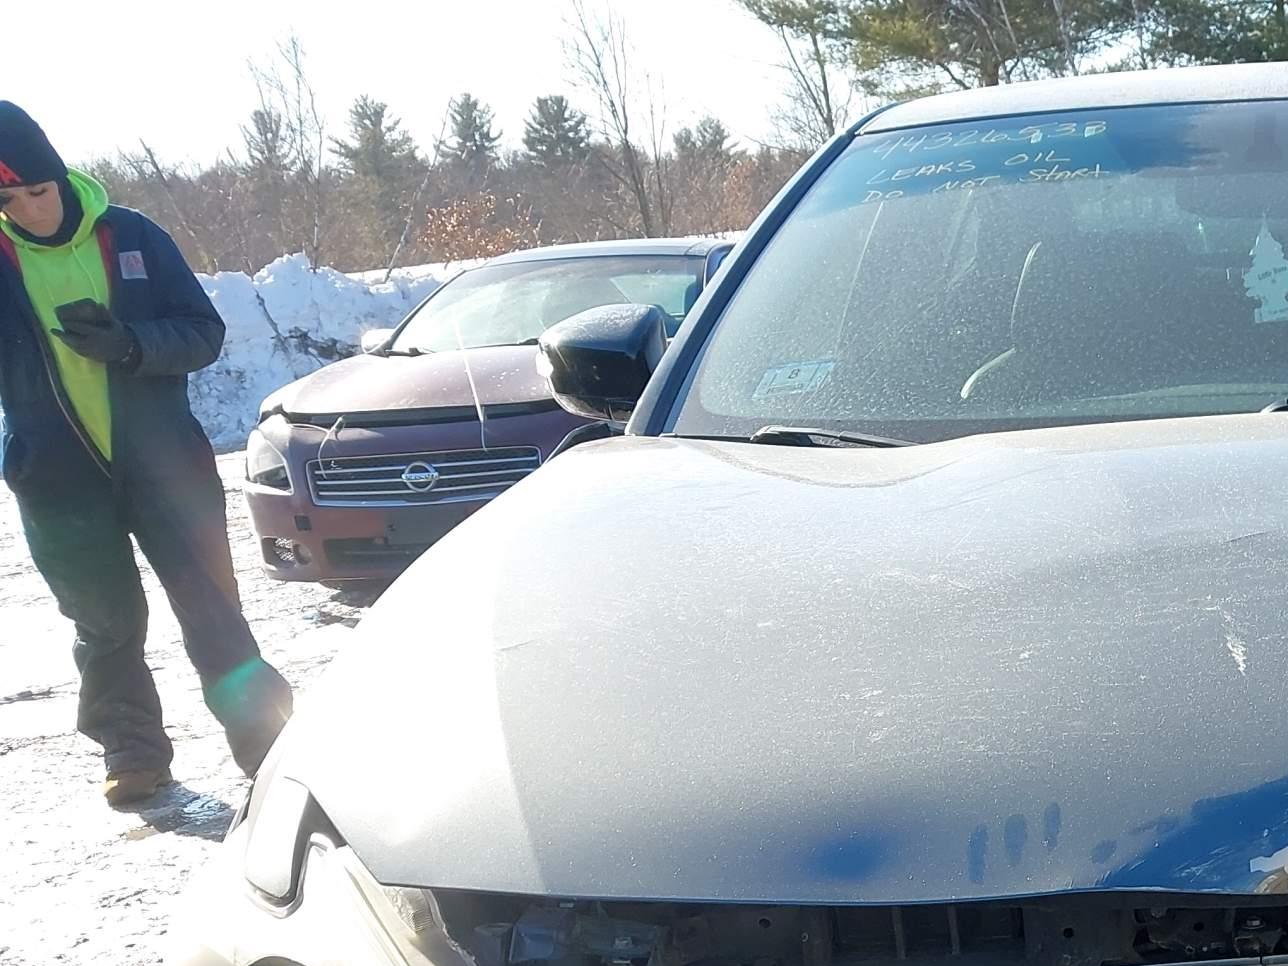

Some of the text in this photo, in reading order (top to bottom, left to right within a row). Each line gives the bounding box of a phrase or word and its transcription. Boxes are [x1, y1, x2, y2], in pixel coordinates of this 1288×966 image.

[866, 151, 1071, 185] LEAKS OIL
[862, 190, 904, 203] DO
[932, 175, 1001, 193] NOT
